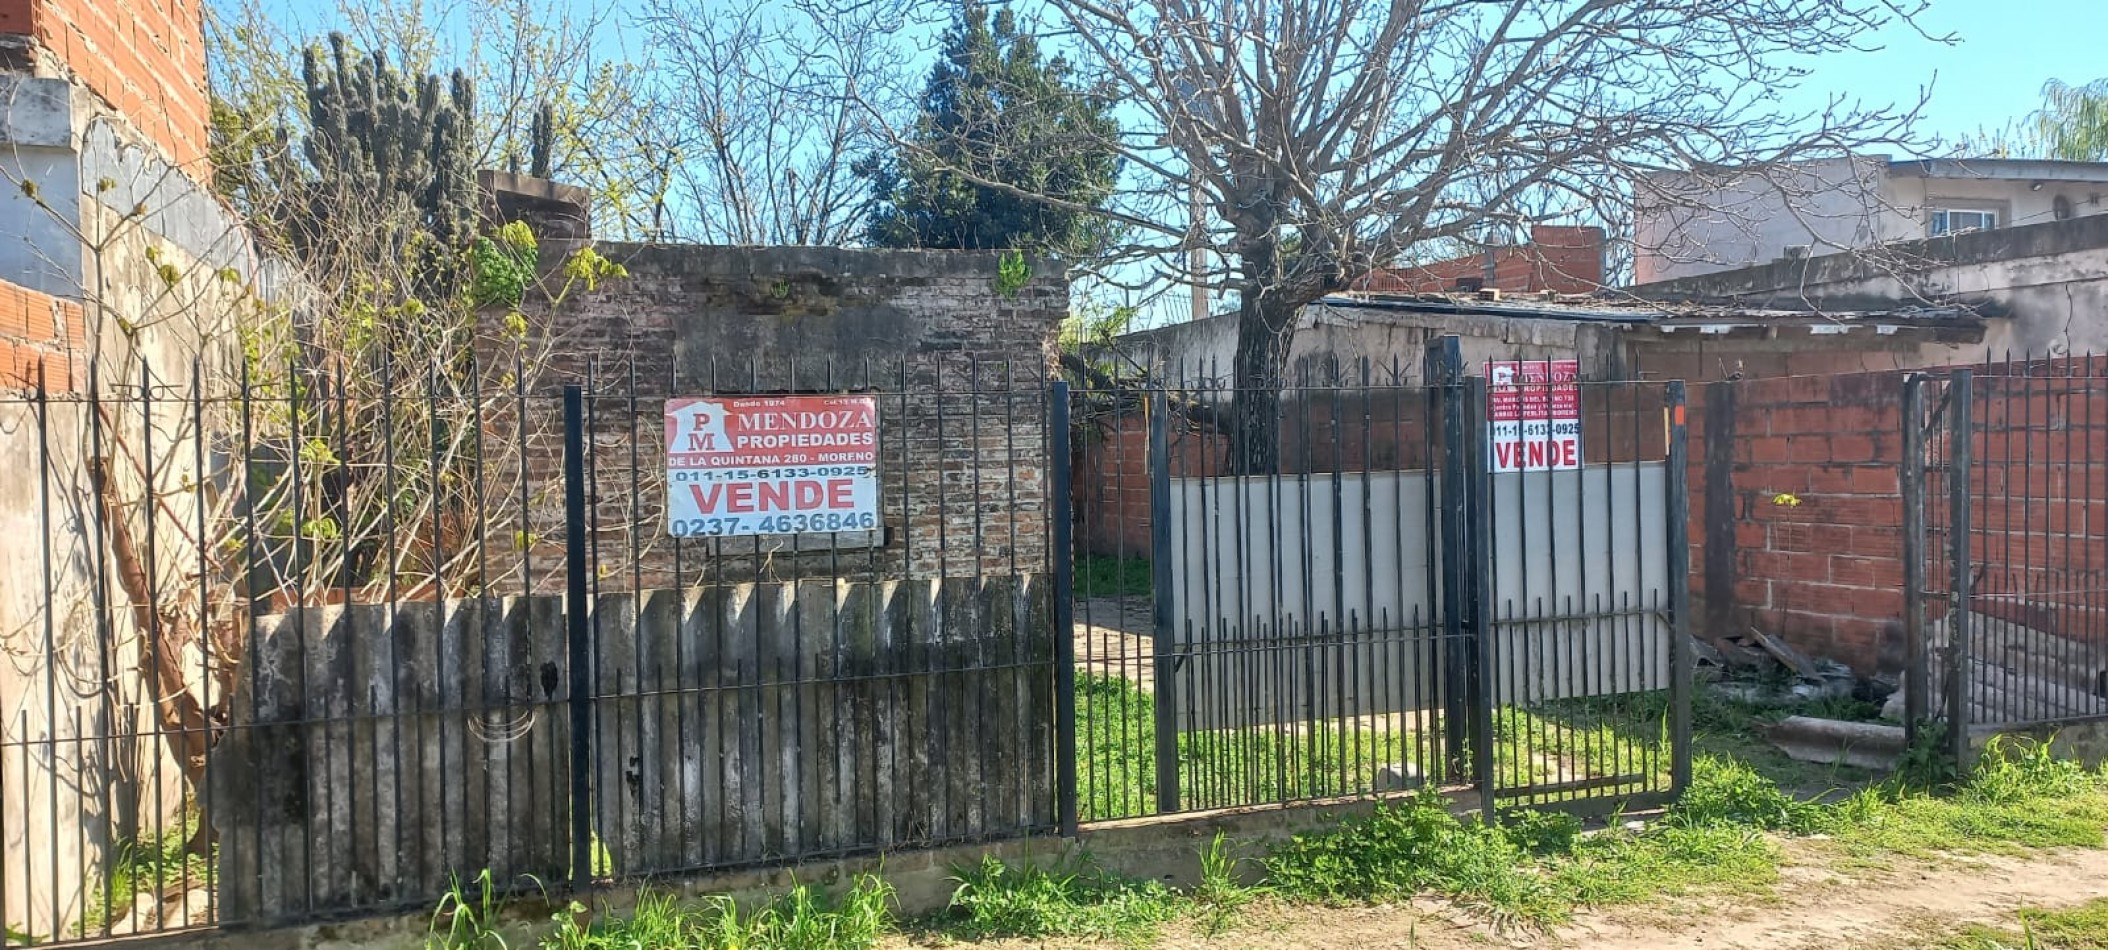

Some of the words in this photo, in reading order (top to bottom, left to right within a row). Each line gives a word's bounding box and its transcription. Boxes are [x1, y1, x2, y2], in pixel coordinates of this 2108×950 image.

[693, 413, 710, 431] P
[738, 410, 874, 431] MENDOZA
[688, 433, 715, 451] M
[737, 431, 873, 449] PROPIEDADES
[669, 456, 686, 466] DE
[690, 455, 706, 466] LA
[711, 454, 780, 465] QUINTANA
[784, 454, 807, 463] 280
[818, 451, 873, 462] MORENO
[1496, 440, 1577, 469] VENDE
[675, 466, 868, 482] 011-15-6133-0925
[689, 479, 854, 514] VENDE
[758, 512, 874, 533] 4636846
